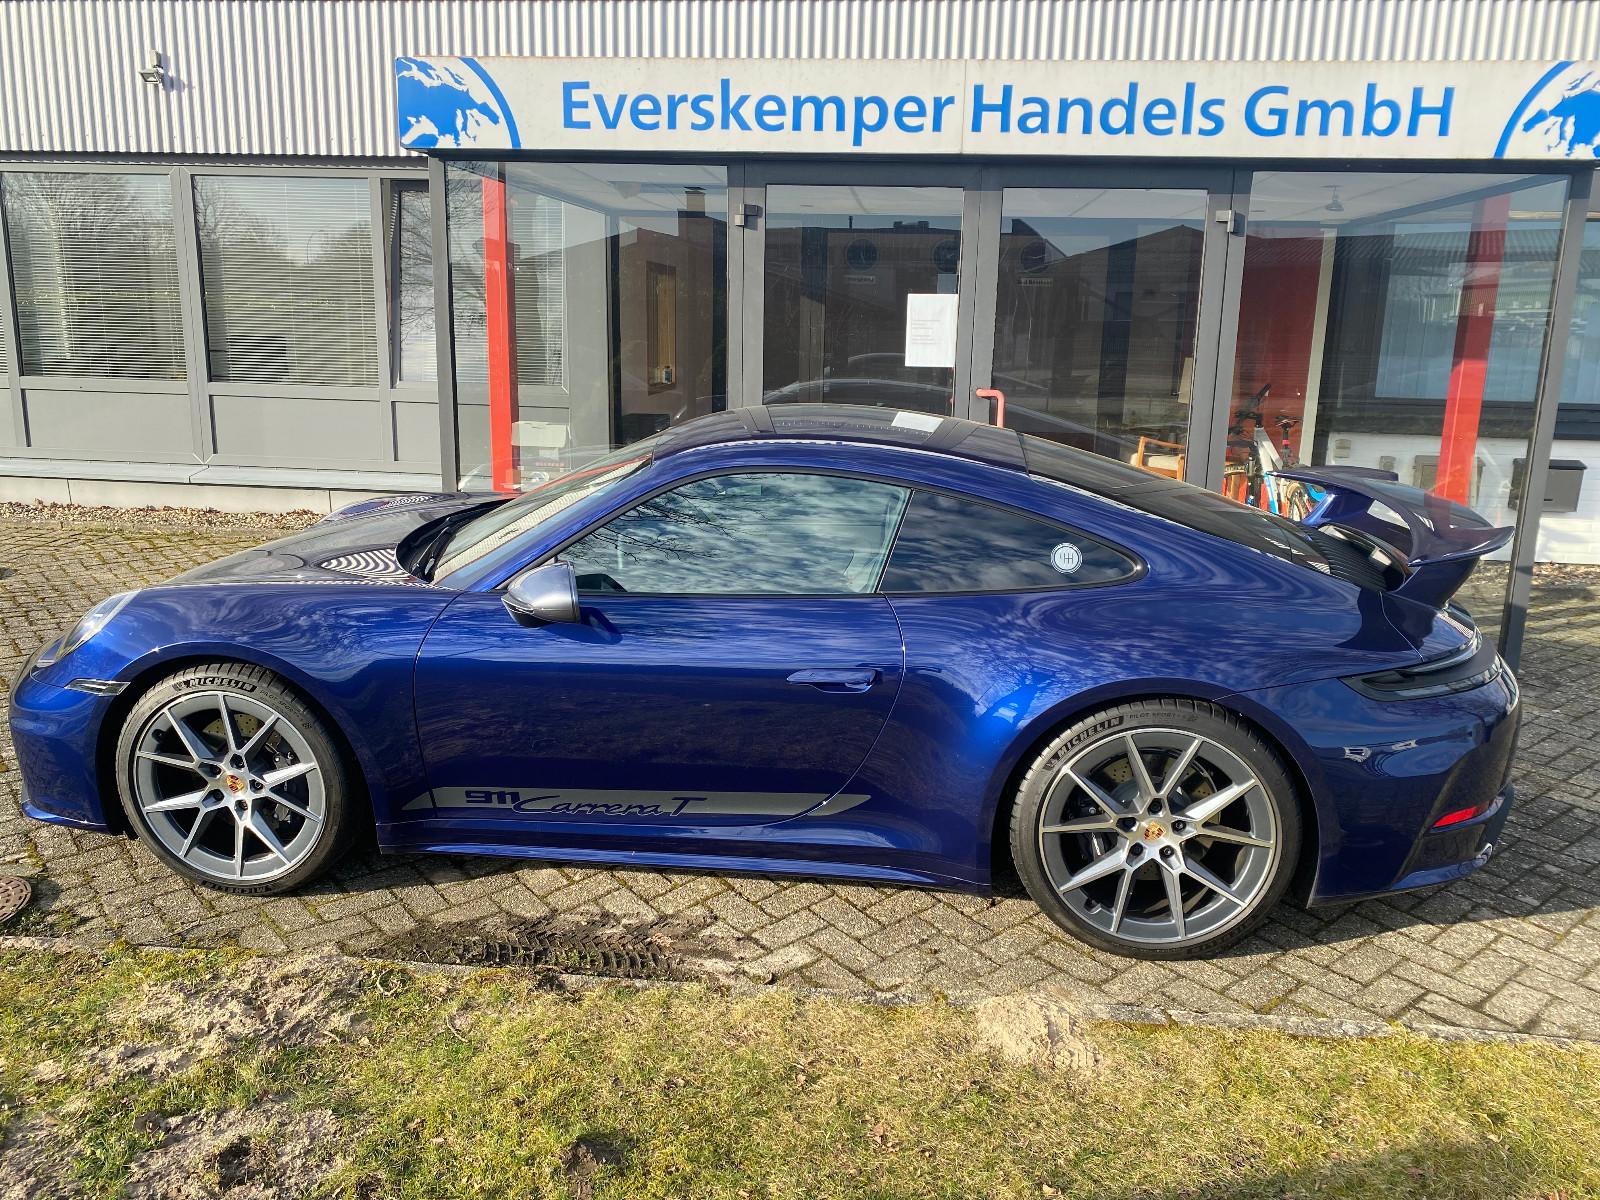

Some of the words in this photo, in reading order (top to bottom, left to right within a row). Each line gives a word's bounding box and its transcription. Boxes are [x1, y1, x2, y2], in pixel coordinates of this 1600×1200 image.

[562, 79, 955, 147] Everskemper
[970, 82, 1225, 137] Handels
[1244, 82, 1454, 137] GmbH
[189, 677, 253, 692] MICHELIN
[1057, 716, 1121, 757] MICHELIN
[465, 790, 520, 804] 911
[512, 795, 663, 816] Carrera
[670, 796, 707, 817] T
